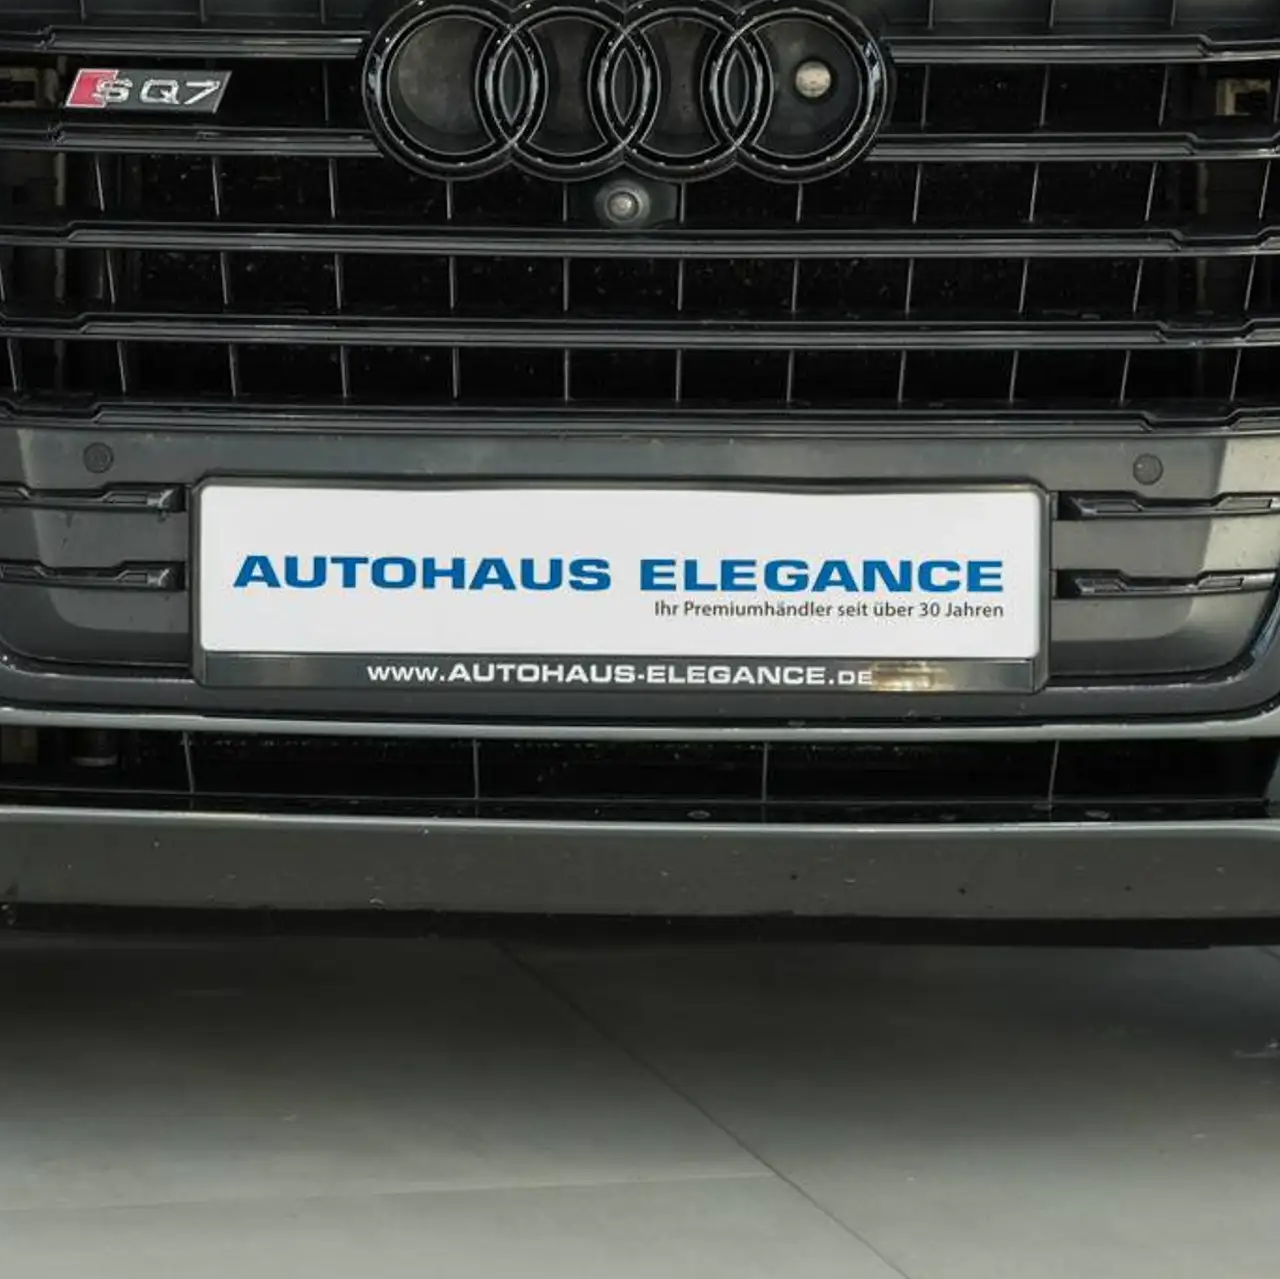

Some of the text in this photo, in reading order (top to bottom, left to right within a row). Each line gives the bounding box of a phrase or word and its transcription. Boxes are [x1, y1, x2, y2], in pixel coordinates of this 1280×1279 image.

[91, 78, 220, 105] SQ7
[232, 554, 1004, 592] AUTOHAUS ELEGANCE
[654, 601, 1004, 618] Ihr Premiumhändler seit über 30 Jahren
